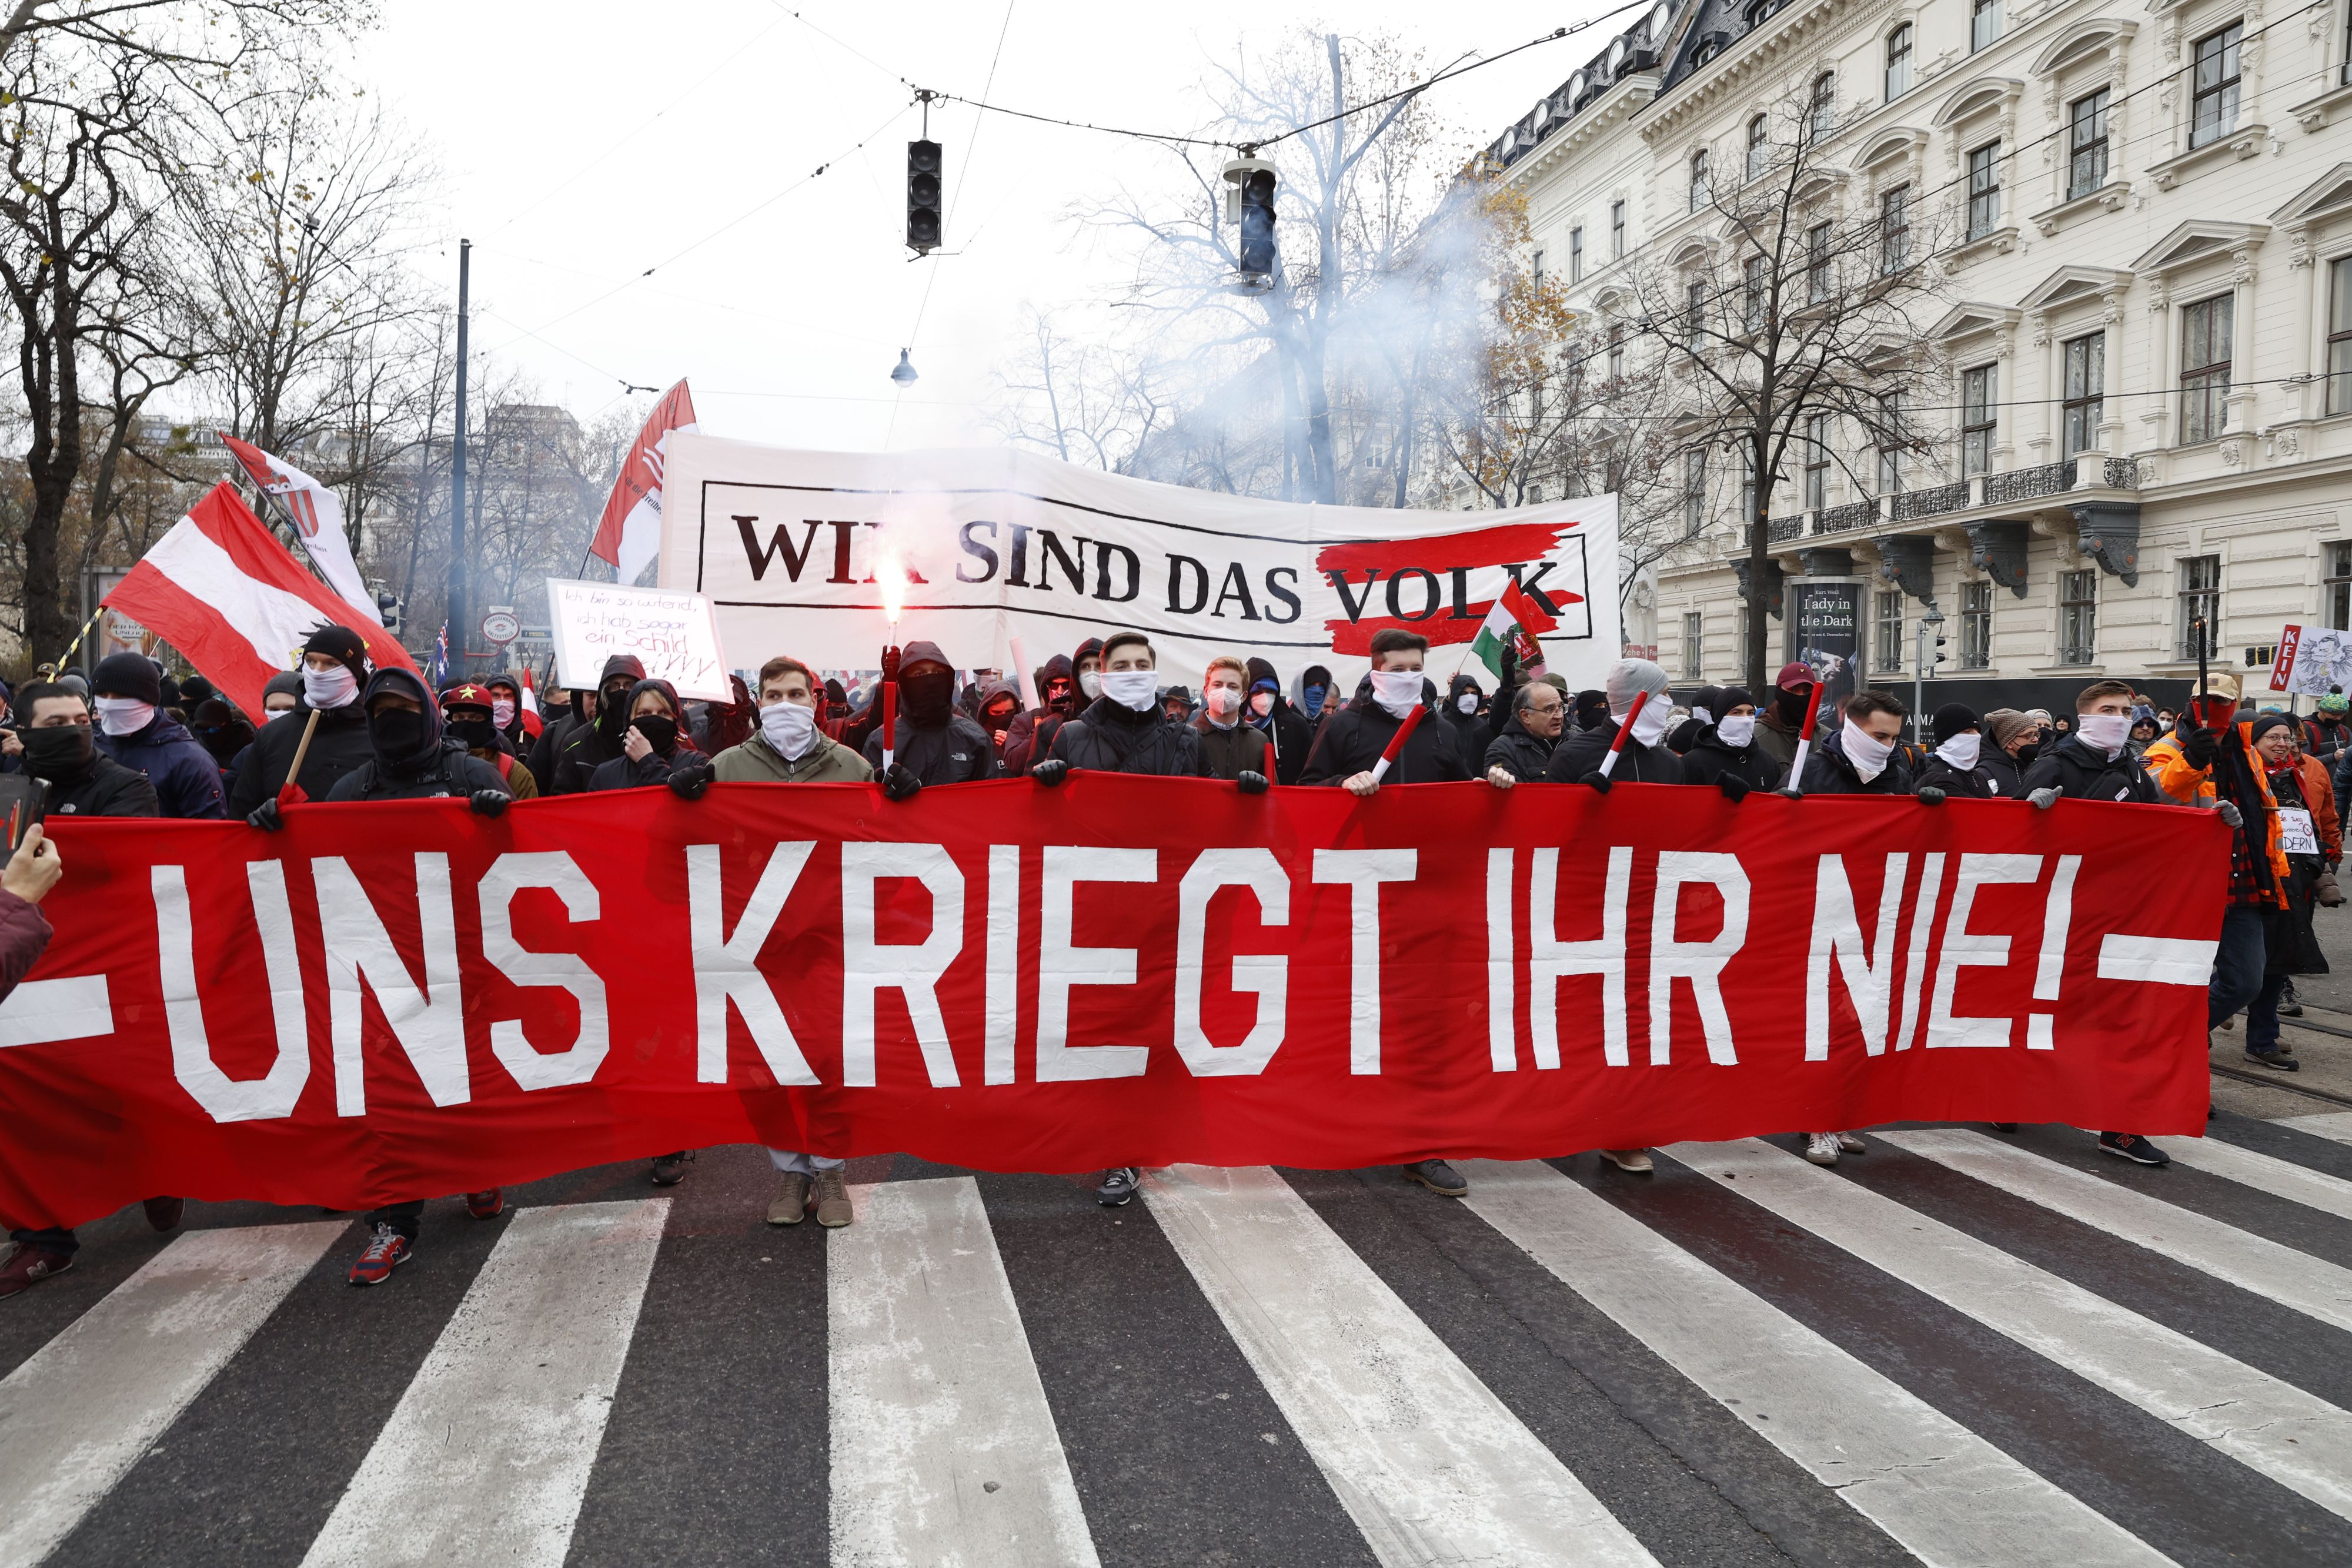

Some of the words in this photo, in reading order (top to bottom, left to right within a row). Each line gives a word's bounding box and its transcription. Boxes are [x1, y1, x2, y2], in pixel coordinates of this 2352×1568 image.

[956, 521, 1141, 603] SIND
[1164, 553, 1301, 624] DAS
[1325, 561, 1566, 625] VOLK
[565, 589, 582, 602] Ich
[590, 591, 610, 605] bin
[617, 597, 633, 607] so
[1838, 597, 1850, 609] in
[486, 616, 515, 627] STRASSENBAHN
[577, 611, 596, 624] ich
[602, 611, 632, 628] hab
[637, 619, 690, 636] sogar
[1823, 614, 1853, 626] Dark
[487, 630, 514, 639] HALTESTELLE
[586, 630, 615, 646] ein
[623, 630, 689, 656] Schild
[2274, 630, 2297, 686] KEIN
[2283, 837, 2312, 851] DERN
[151, 850, 610, 1124] UNS
[686, 840, 1418, 1089] KRIEGT
[1486, 847, 1752, 1072] IHR
[1805, 852, 2083, 1063] NIE!
